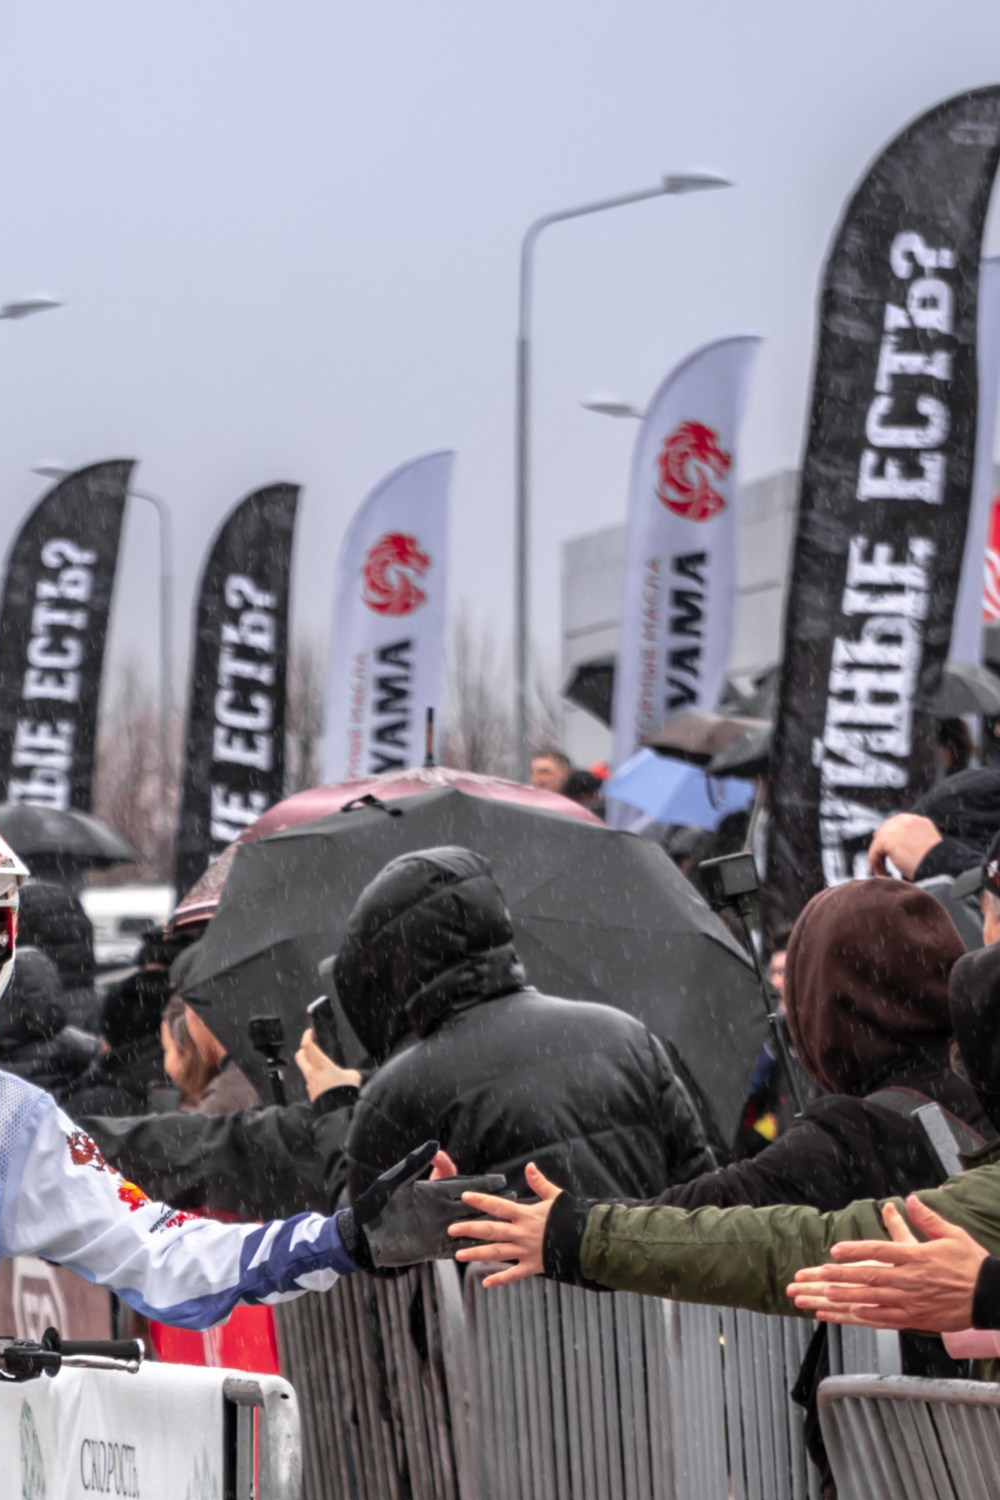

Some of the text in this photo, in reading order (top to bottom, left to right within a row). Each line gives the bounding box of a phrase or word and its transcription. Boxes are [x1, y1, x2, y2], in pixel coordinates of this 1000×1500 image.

[856, 229, 960, 505] ЕСТЬ?
[22, 538, 98, 702] ЕСТЬ?
[211, 573, 277, 771] ЕСТЬ?
